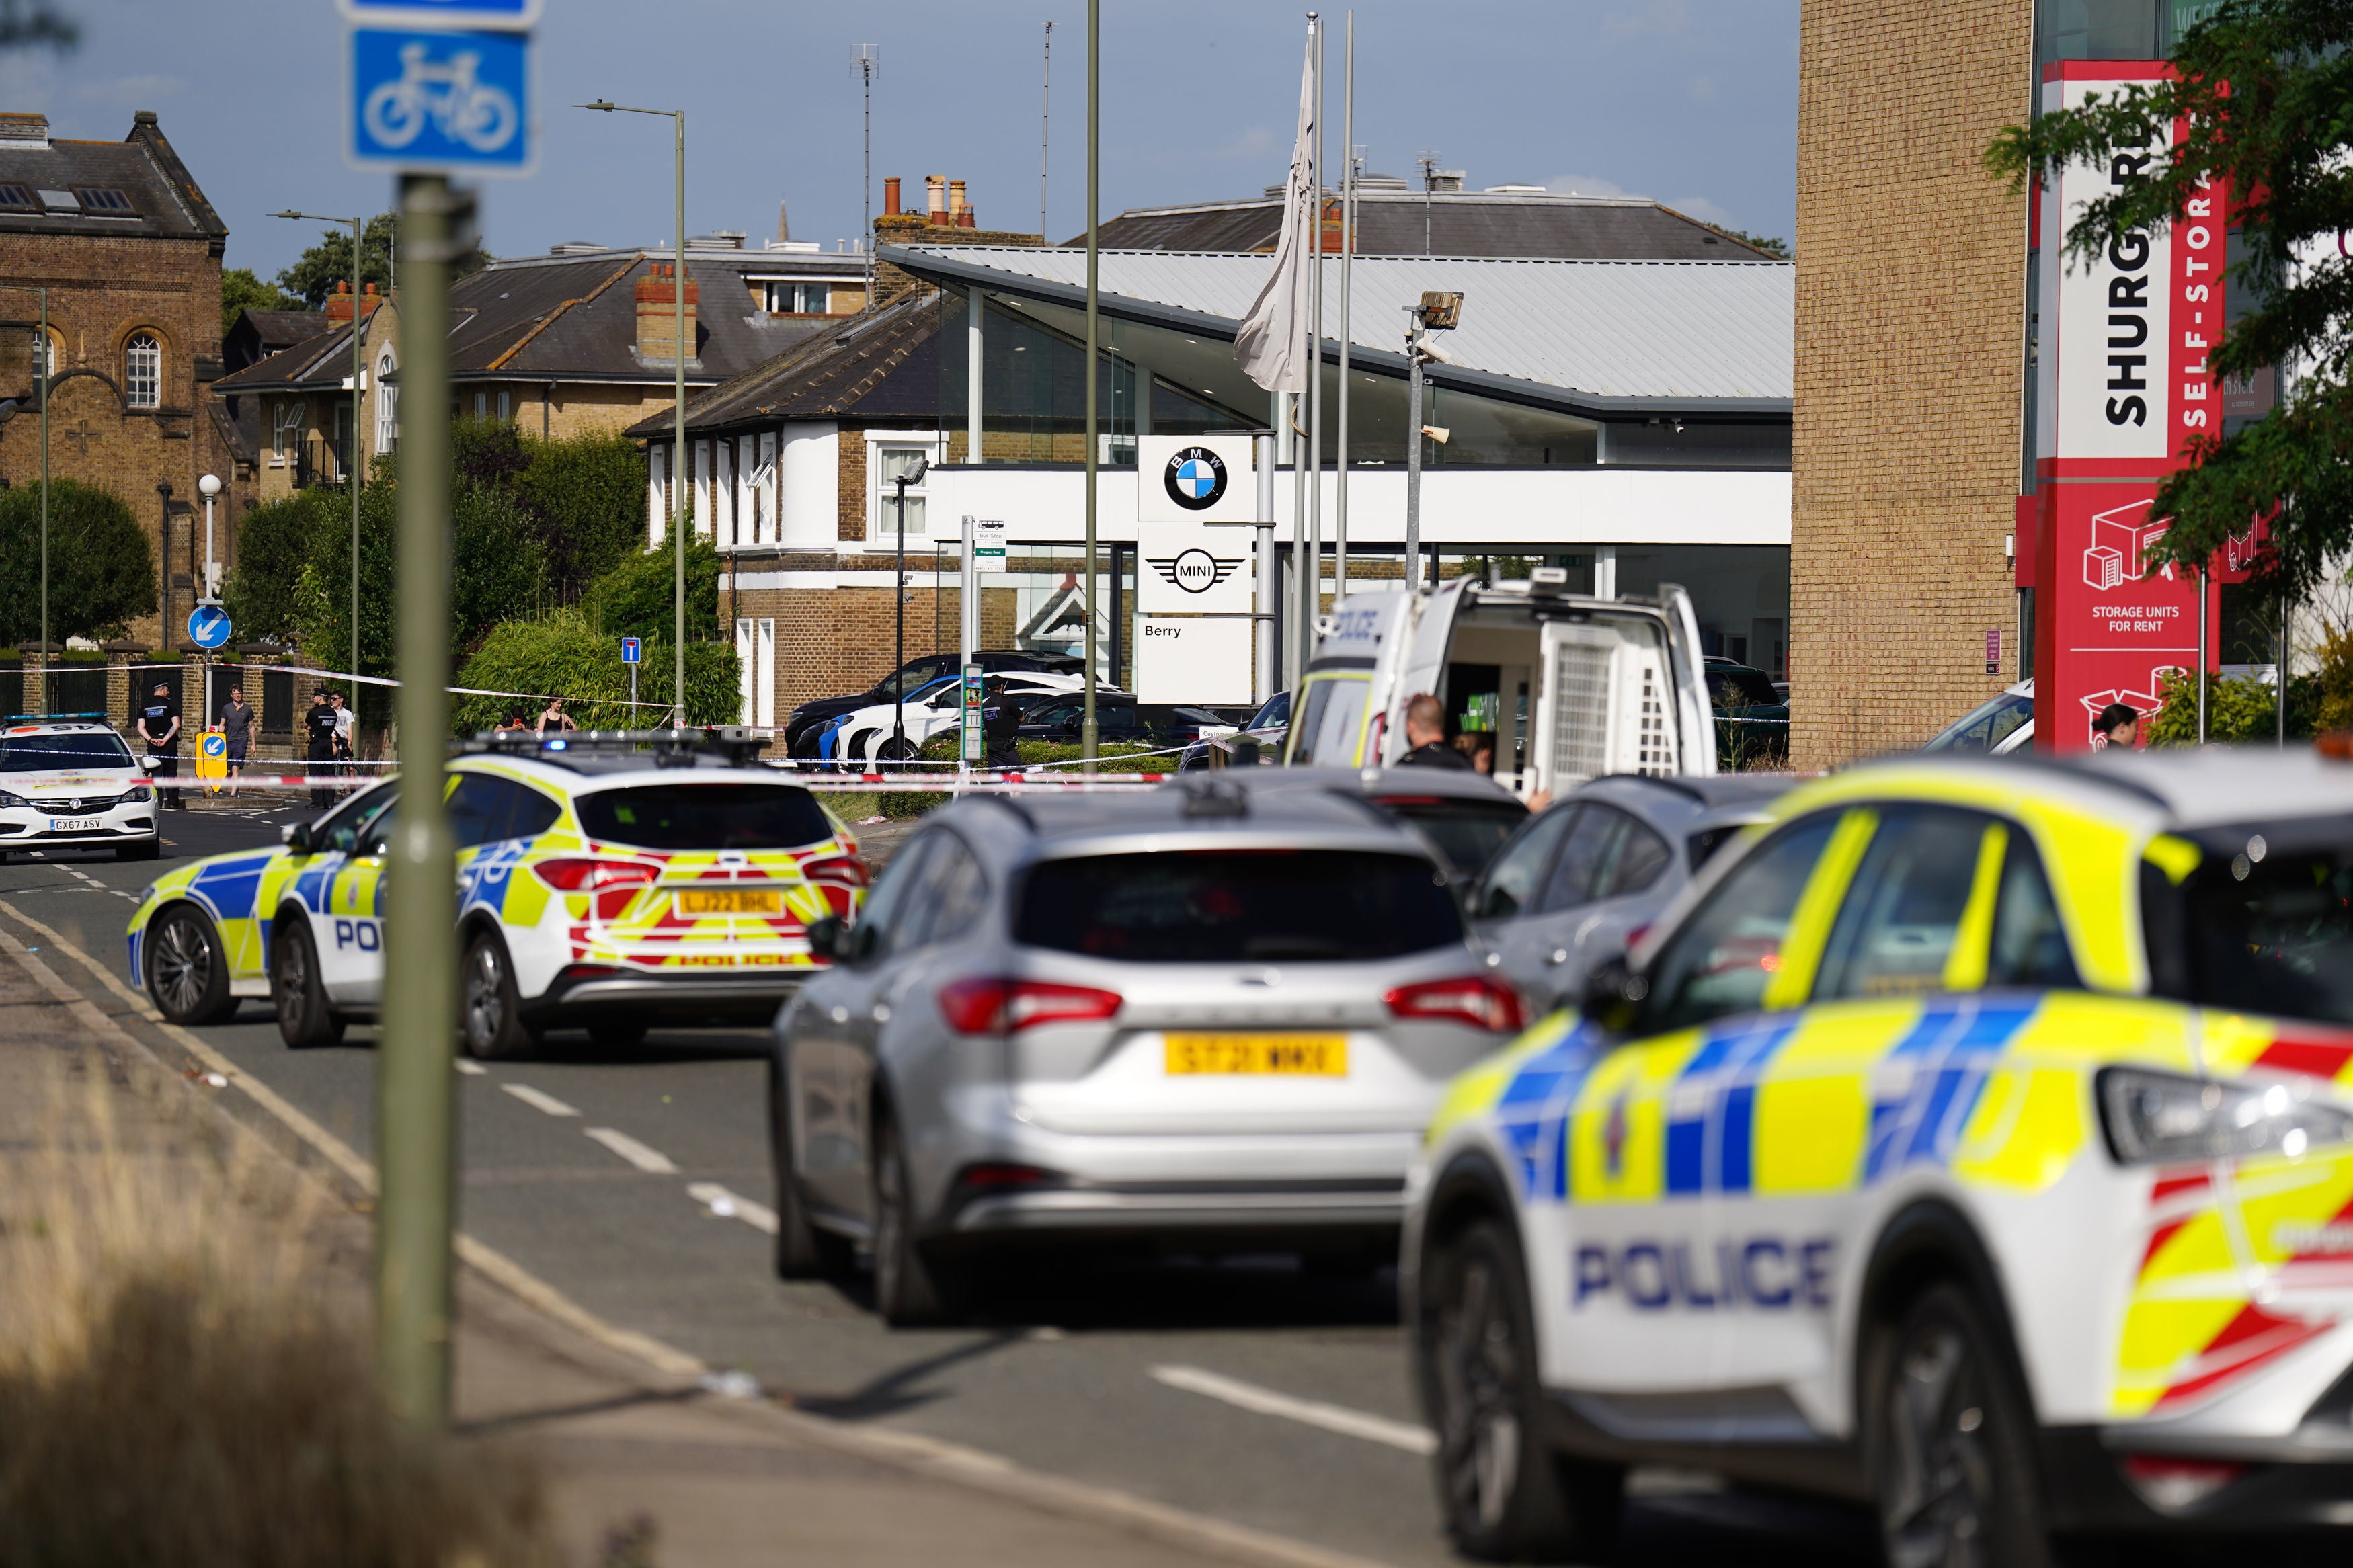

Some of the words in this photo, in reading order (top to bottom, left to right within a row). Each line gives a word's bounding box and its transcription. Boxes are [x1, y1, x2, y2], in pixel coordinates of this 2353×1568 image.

[2106, 111, 2151, 427] SHURGRD
[2183, 112, 2212, 428] SELF-STORA
[1170, 448, 1222, 469] BMW
[1180, 566, 1210, 577] MINI
[2092, 606, 2143, 618] STORAGE
[2146, 606, 2180, 618] UNITS
[1145, 626, 1181, 638] Berry
[2109, 621, 2130, 632] FOR
[2134, 621, 2163, 632] RENT
[56, 821, 80, 830] GX67
[83, 820, 100, 828] ASV
[680, 954, 793, 966] POLICE
[1573, 1238, 1837, 1311] POLICE
